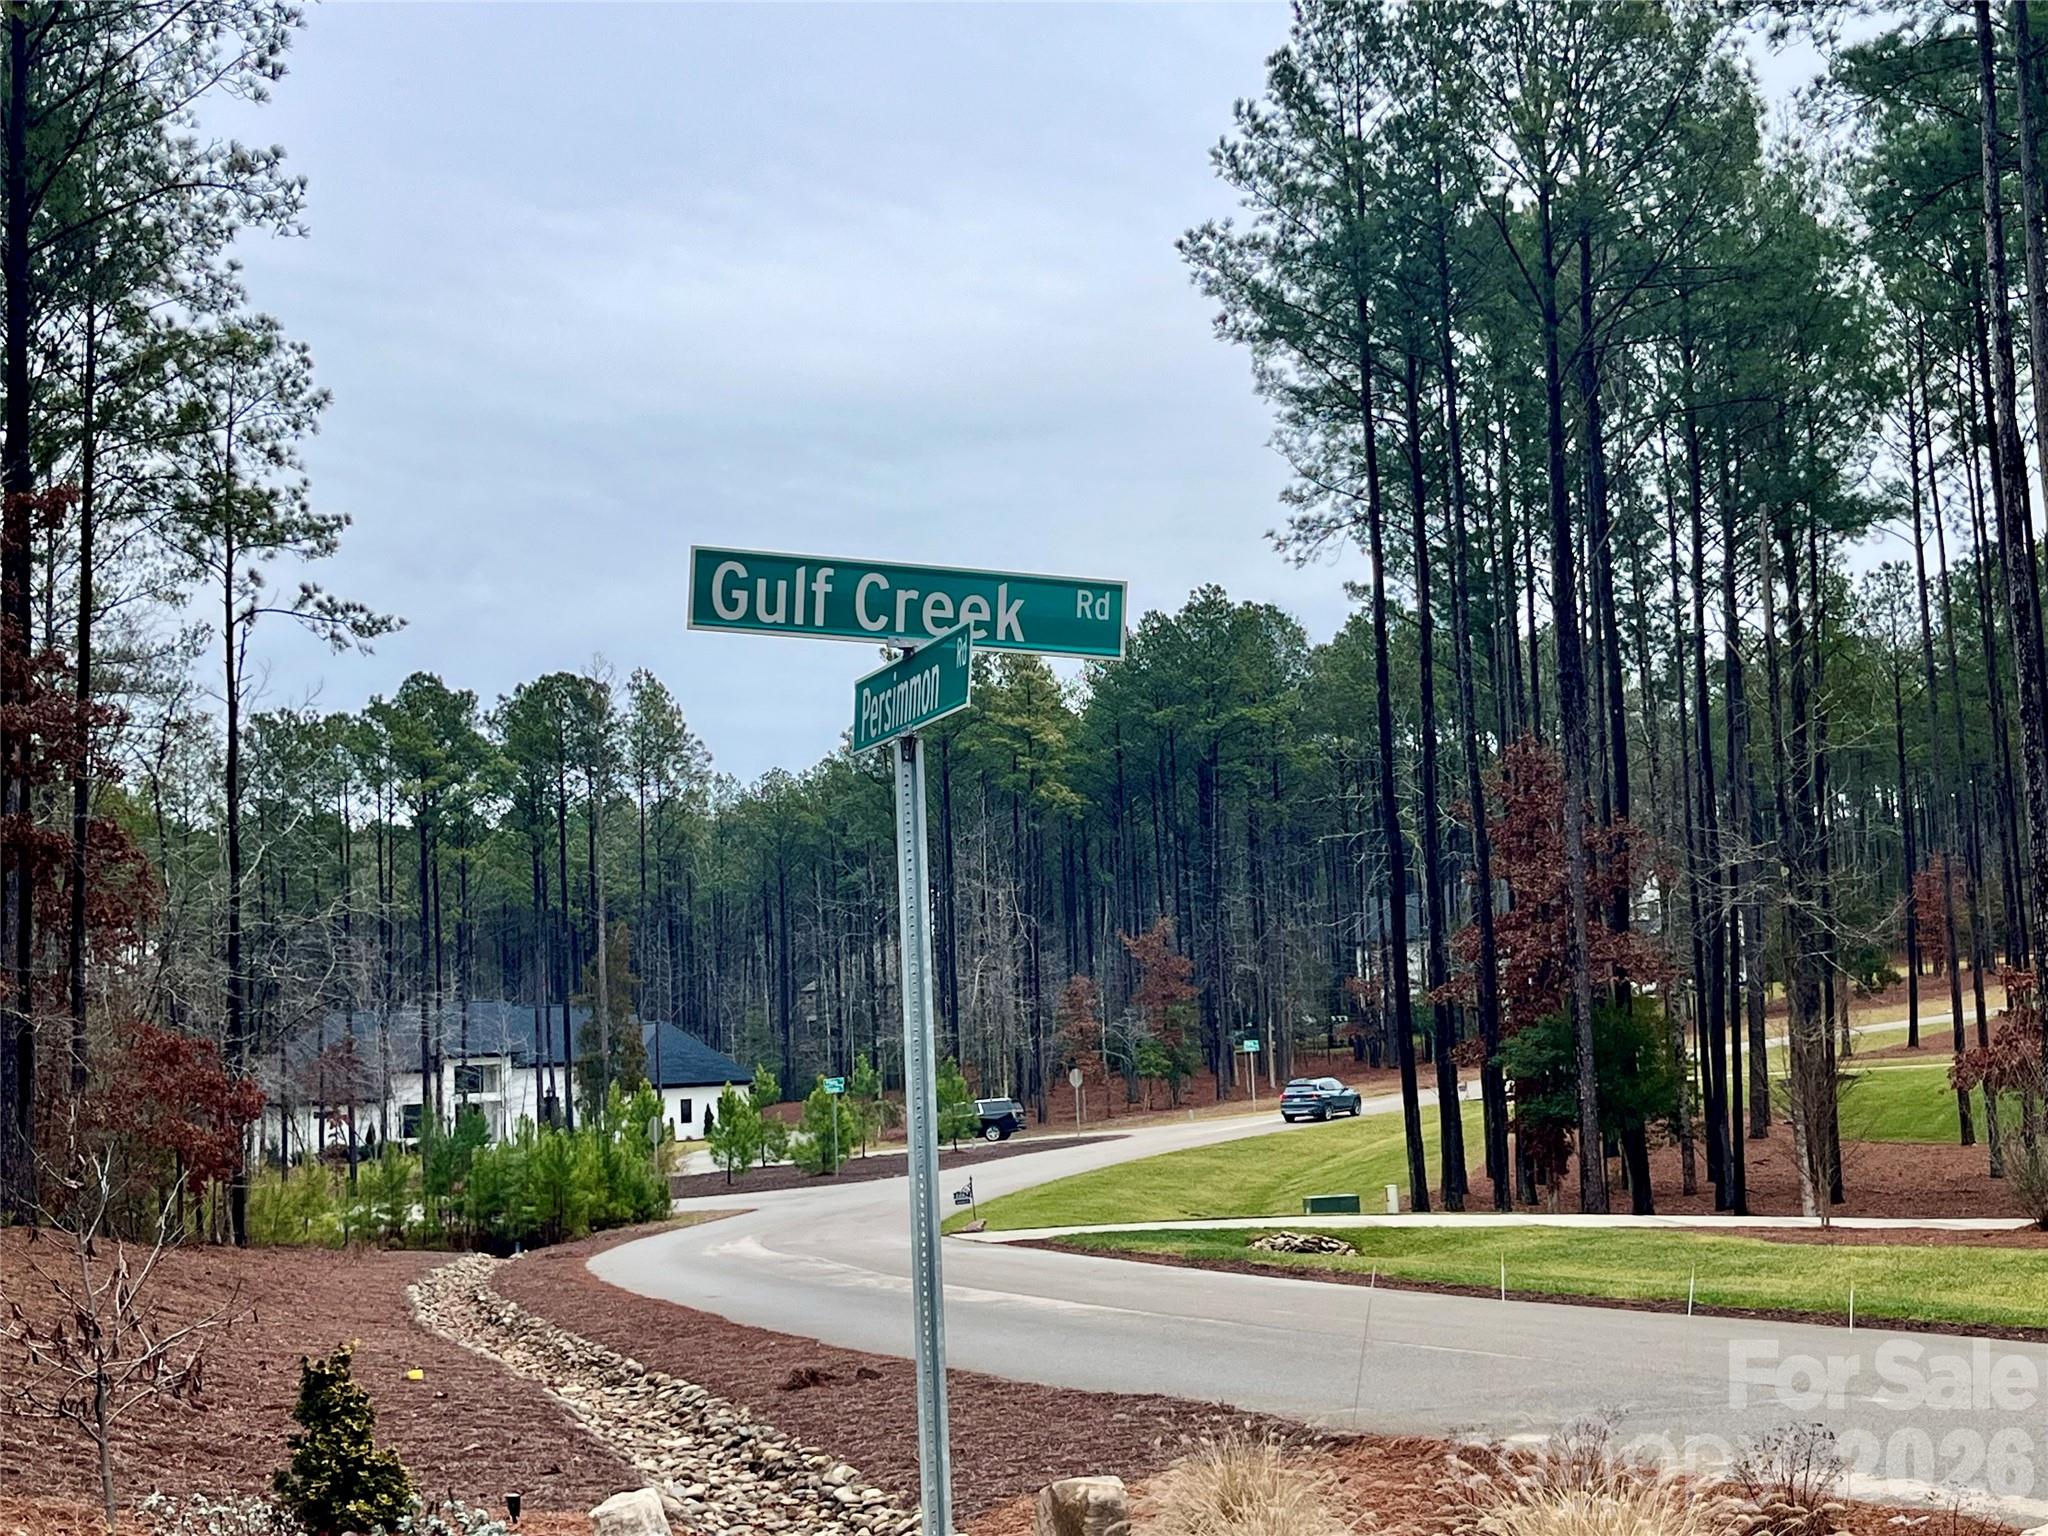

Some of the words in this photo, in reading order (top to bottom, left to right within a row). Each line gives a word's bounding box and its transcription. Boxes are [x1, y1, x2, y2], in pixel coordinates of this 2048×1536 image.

[712, 560, 835, 627] Gulf
[855, 572, 1026, 643] Creek
[1076, 589, 1111, 622] Rd
[861, 664, 940, 742] Persimmon
[956, 632, 969, 669] Rd
